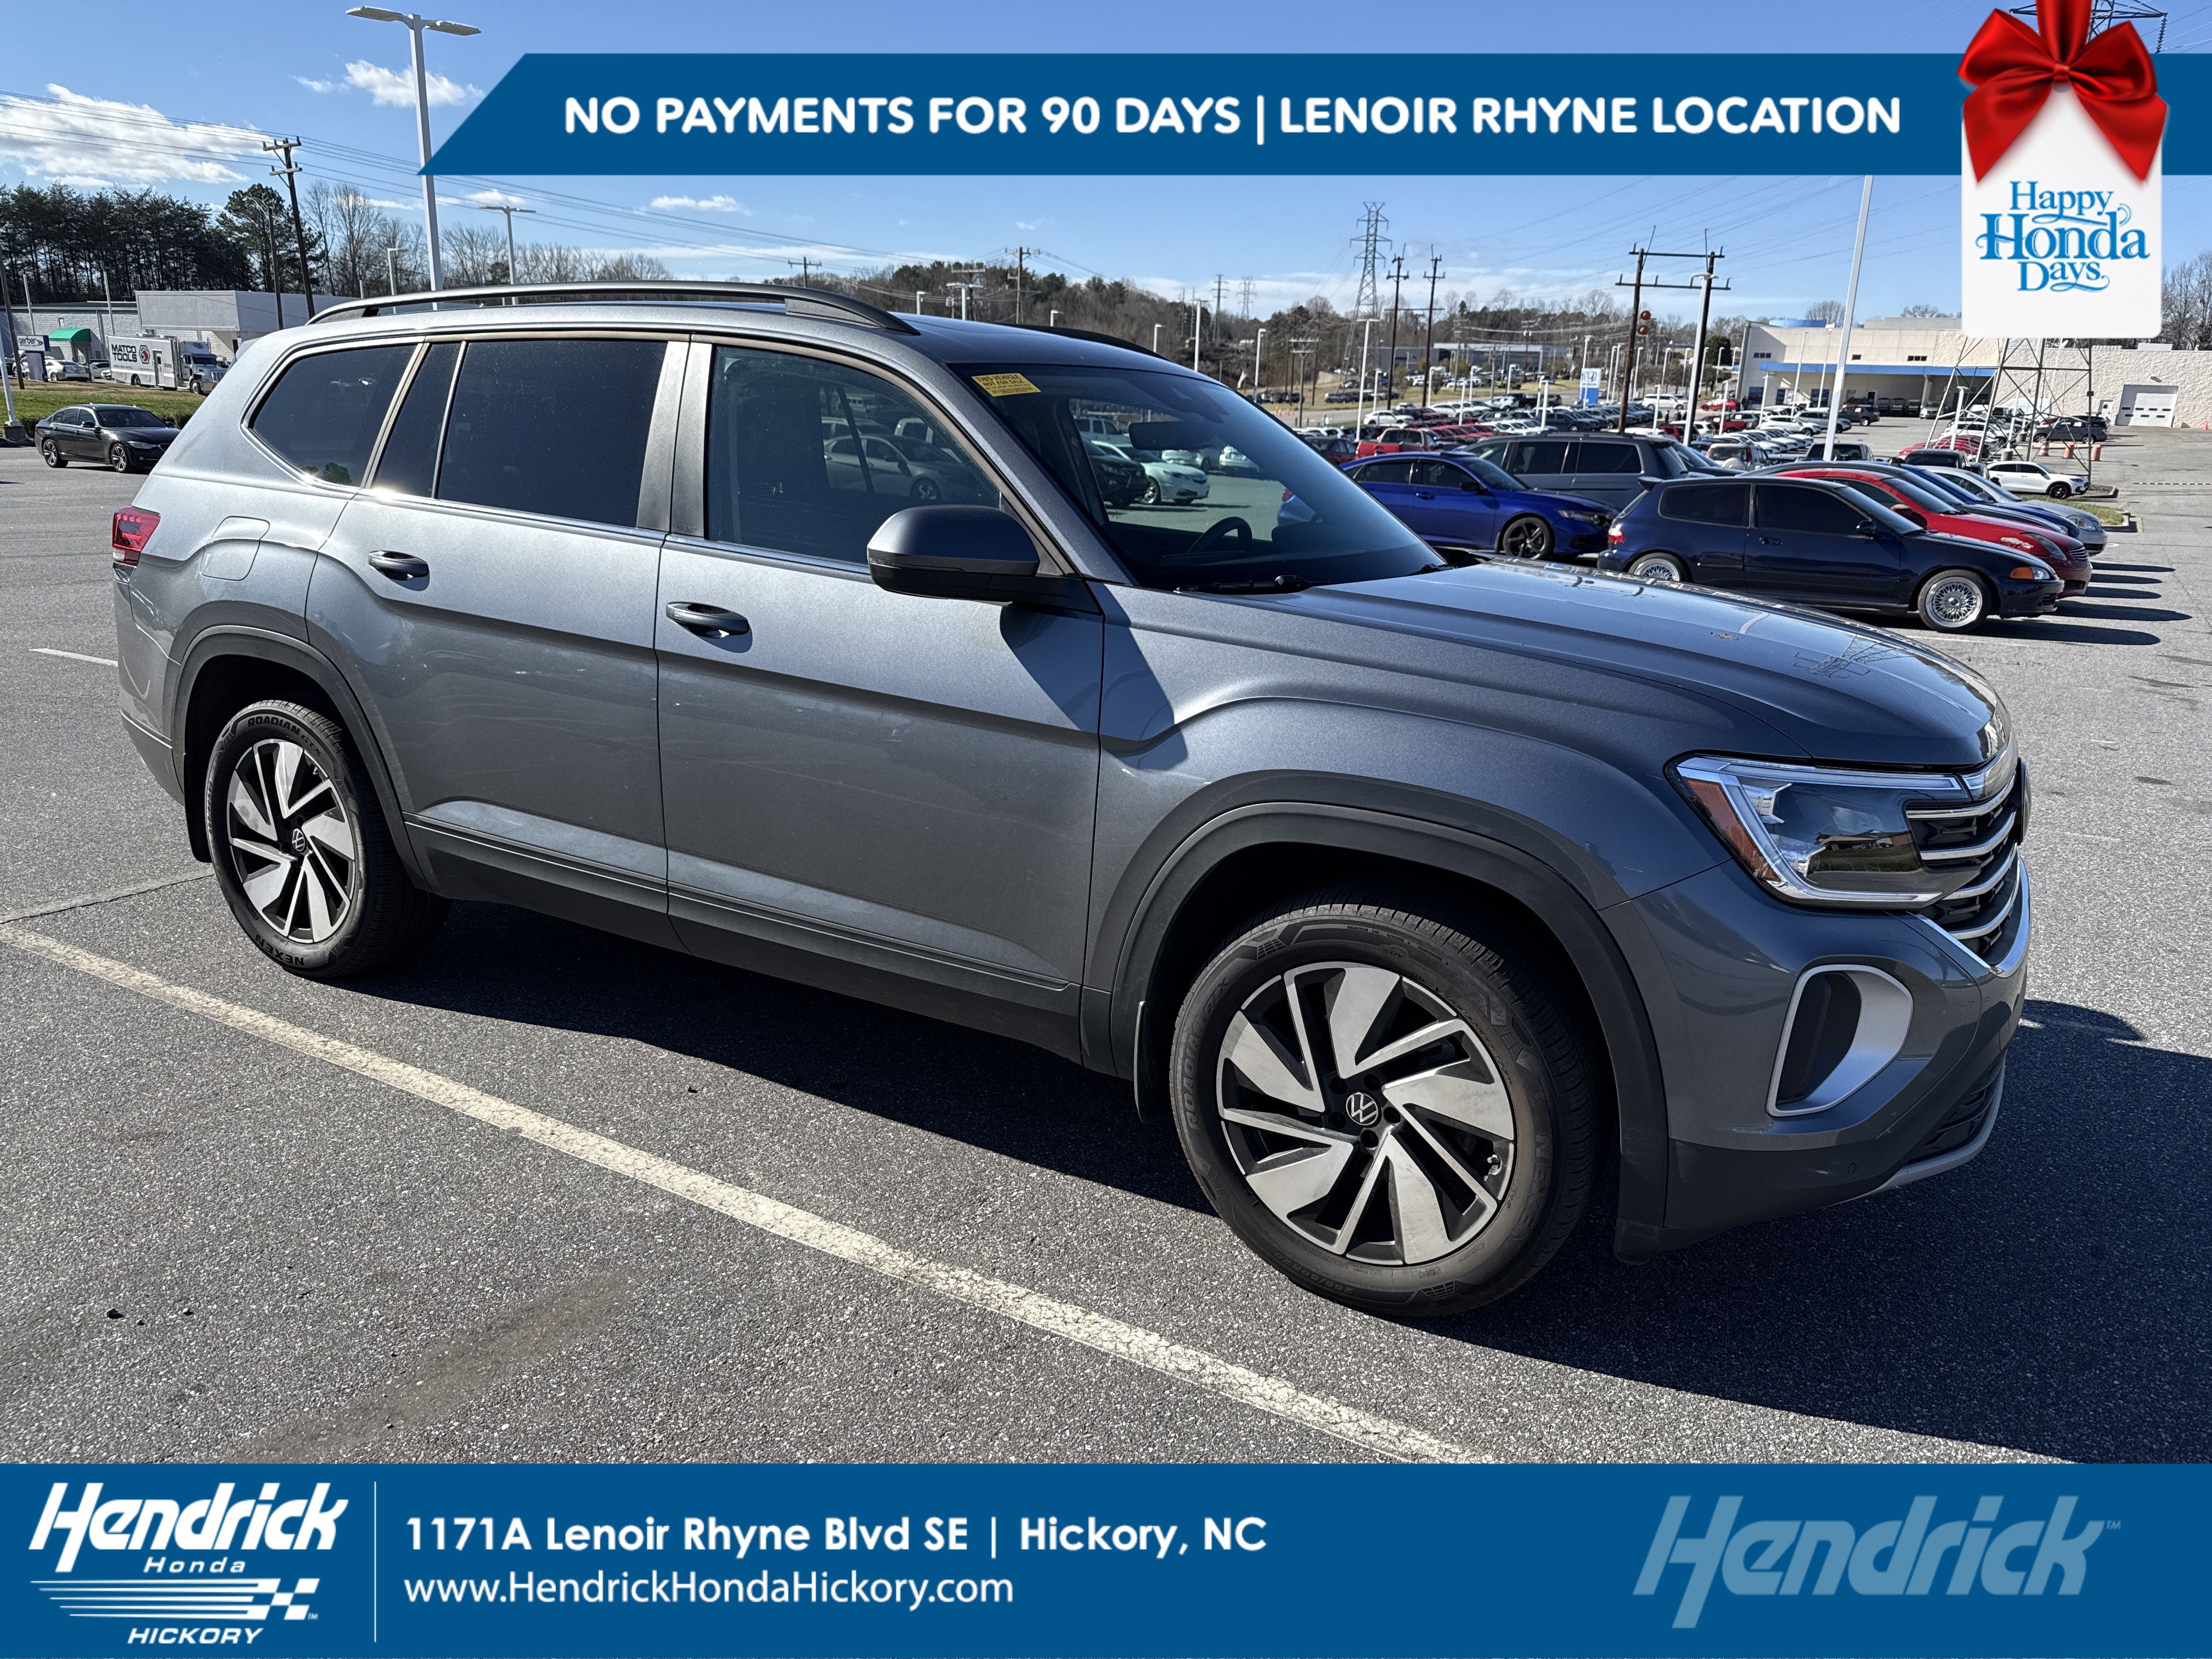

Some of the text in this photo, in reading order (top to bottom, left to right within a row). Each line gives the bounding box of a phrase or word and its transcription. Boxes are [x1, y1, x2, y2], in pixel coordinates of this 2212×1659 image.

[111, 344, 137, 354] MATCO
[112, 352, 137, 362] TOOLS
[248, 716, 322, 756] ROADIAN GTX
[255, 934, 304, 966] NEXEN
